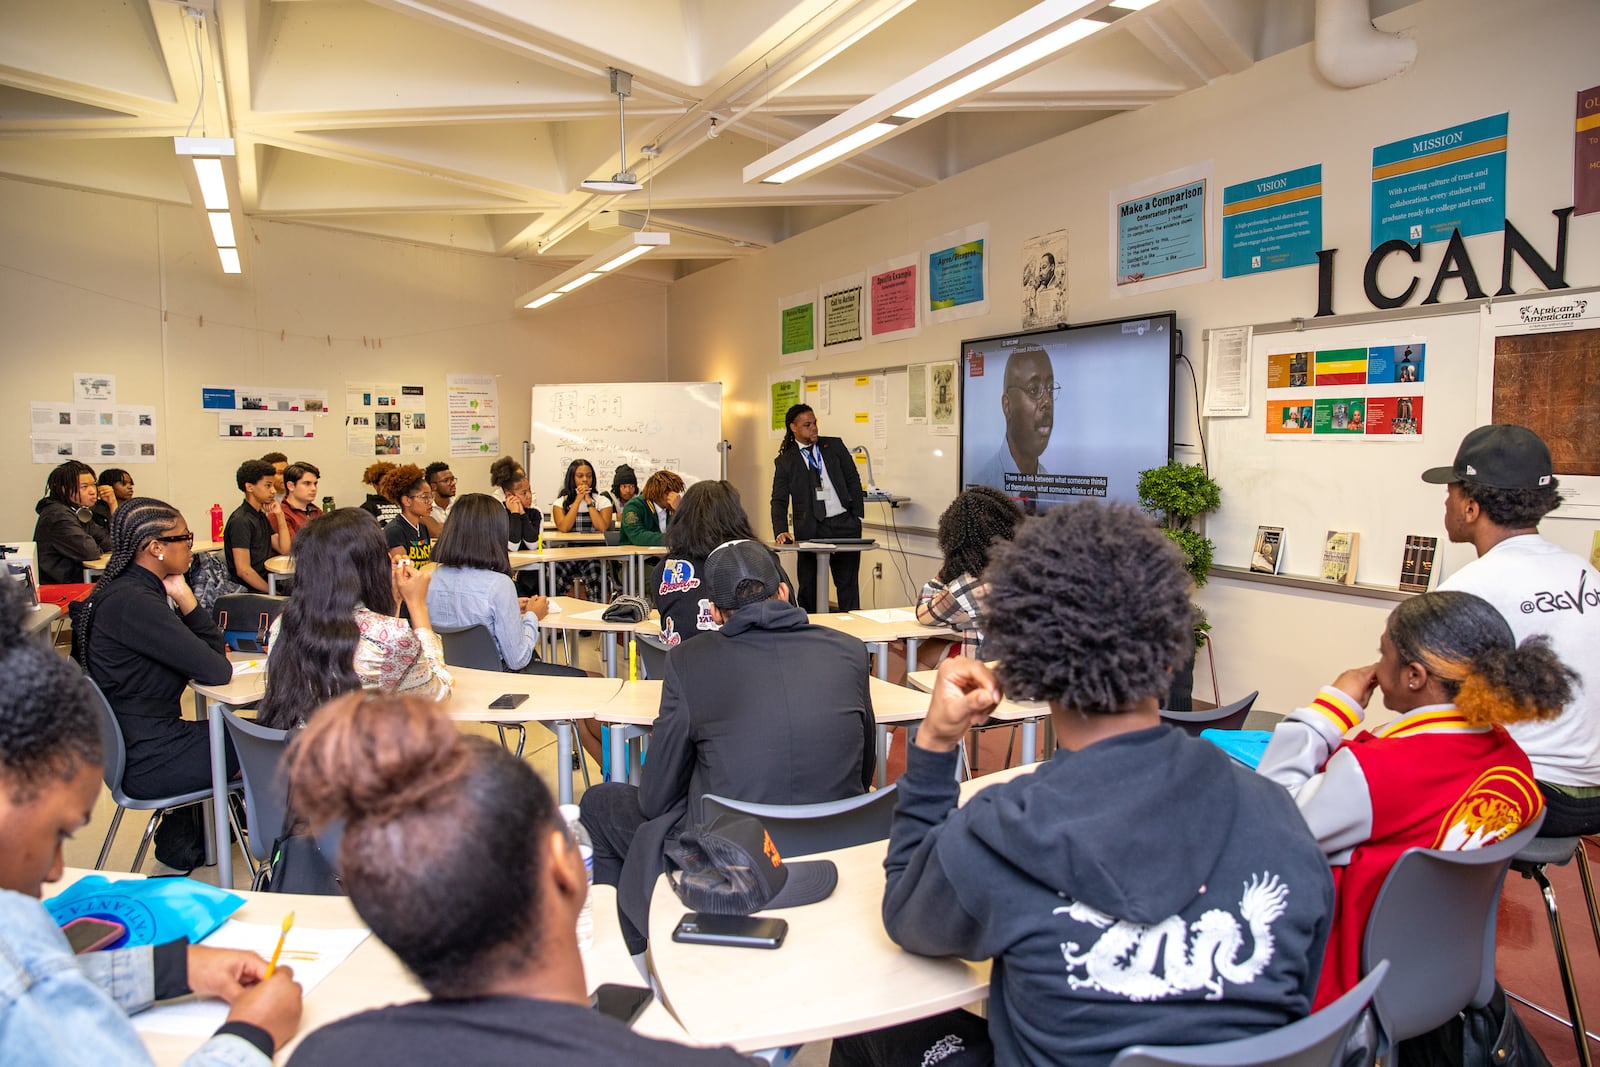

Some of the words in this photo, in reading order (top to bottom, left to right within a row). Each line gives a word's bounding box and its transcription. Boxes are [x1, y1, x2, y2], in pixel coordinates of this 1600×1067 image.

[1412, 132, 1463, 153] MISSION
[1256, 178, 1287, 192] VISION
[1388, 188, 1402, 196] With
[1408, 182, 1427, 192] caring
[1428, 179, 1449, 188] culture
[1458, 172, 1473, 181] trust
[1475, 168, 1488, 176] and
[1389, 196, 1429, 209] collaboration,
[1430, 192, 1448, 201] every
[1449, 185, 1472, 196] student
[1473, 182, 1486, 191] will
[1120, 204, 1143, 217] Make
[1152, 186, 1202, 208] Comparison
[1137, 209, 1167, 221] Conversation
[1168, 204, 1188, 214] prompts
[1382, 213, 1406, 224] graduate
[1408, 209, 1424, 218] ready
[1425, 206, 1435, 214] for
[1436, 202, 1457, 212] college
[1458, 200, 1470, 208] and
[1471, 195, 1494, 205] career.
[1314, 248, 1338, 317] I
[1364, 206, 1575, 310] CAN
[1524, 312, 1581, 323] Americans
[1533, 305, 1573, 316] African
[70, 902, 148, 933] ATLANTA
